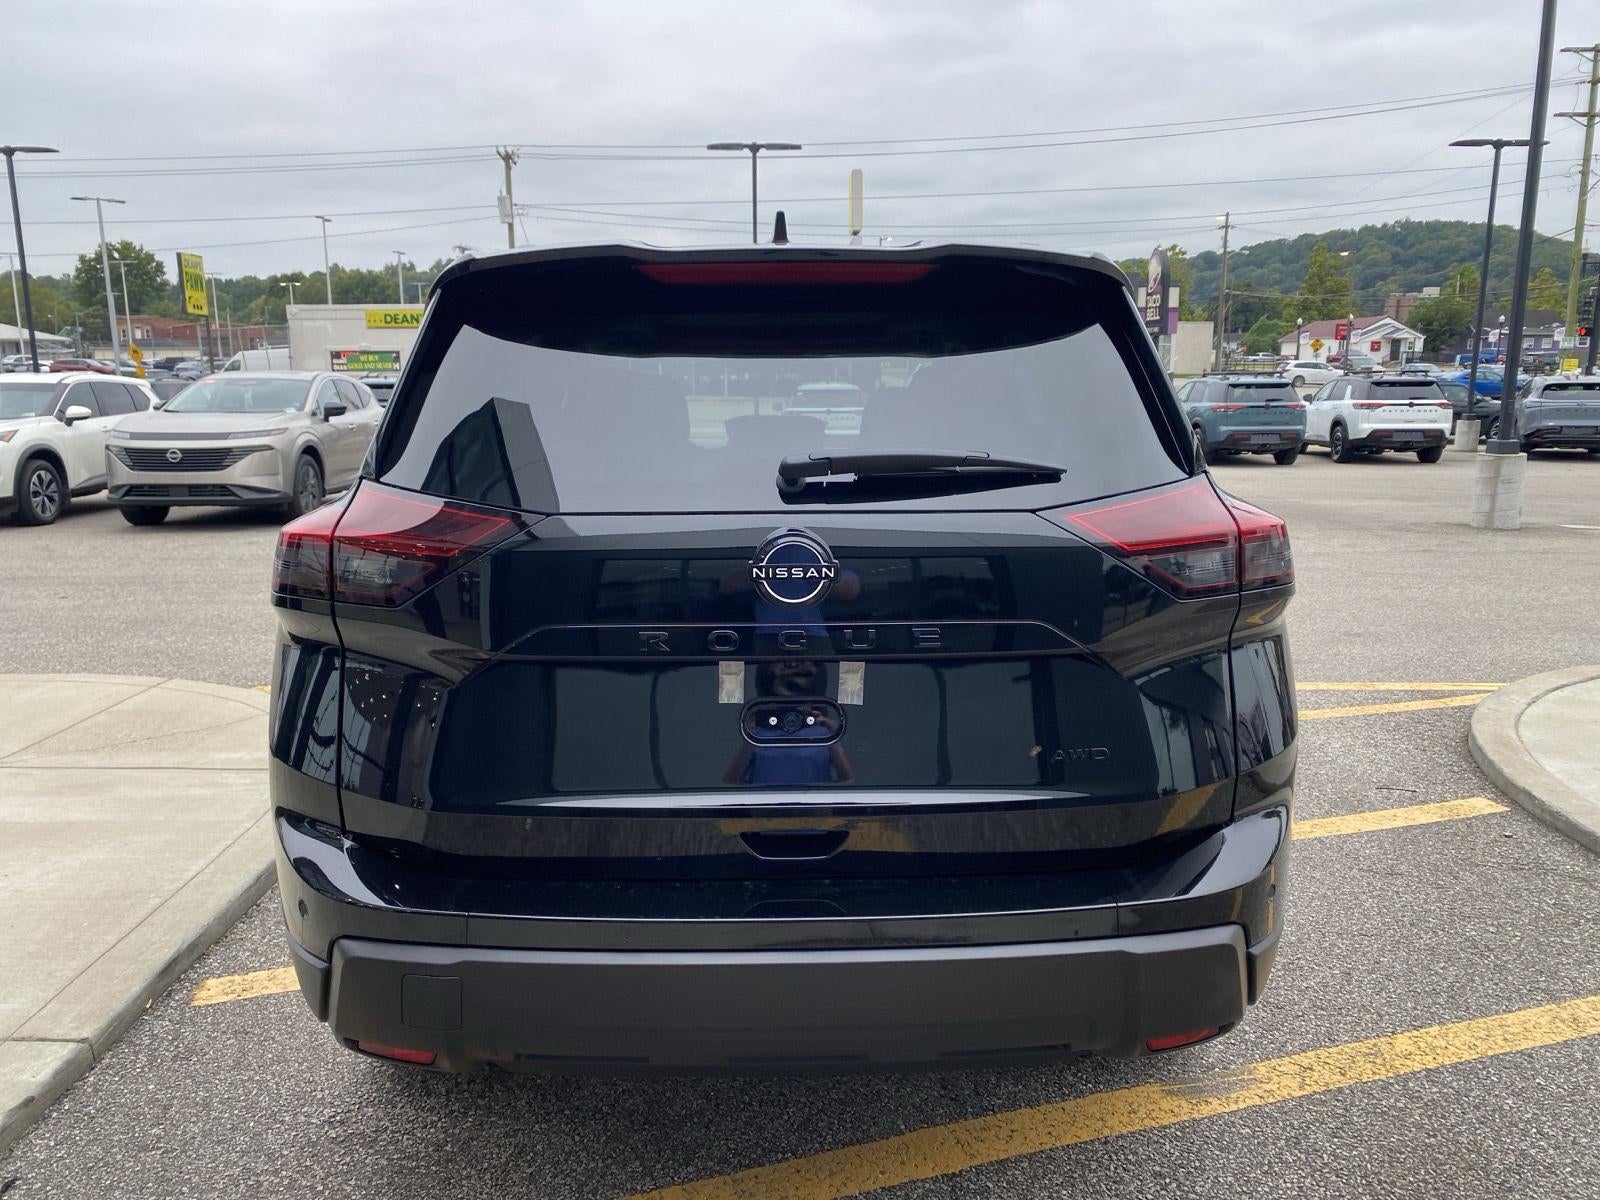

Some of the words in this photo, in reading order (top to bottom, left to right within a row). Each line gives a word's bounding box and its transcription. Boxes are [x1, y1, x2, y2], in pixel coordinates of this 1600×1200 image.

[184, 270, 204, 292] PAWN
[1146, 294, 1161, 308] TACO
[1146, 308, 1160, 321] BELL
[751, 566, 836, 579] NISSAN
[638, 629, 943, 652] ROGUE
[1049, 746, 1109, 762] AWD
